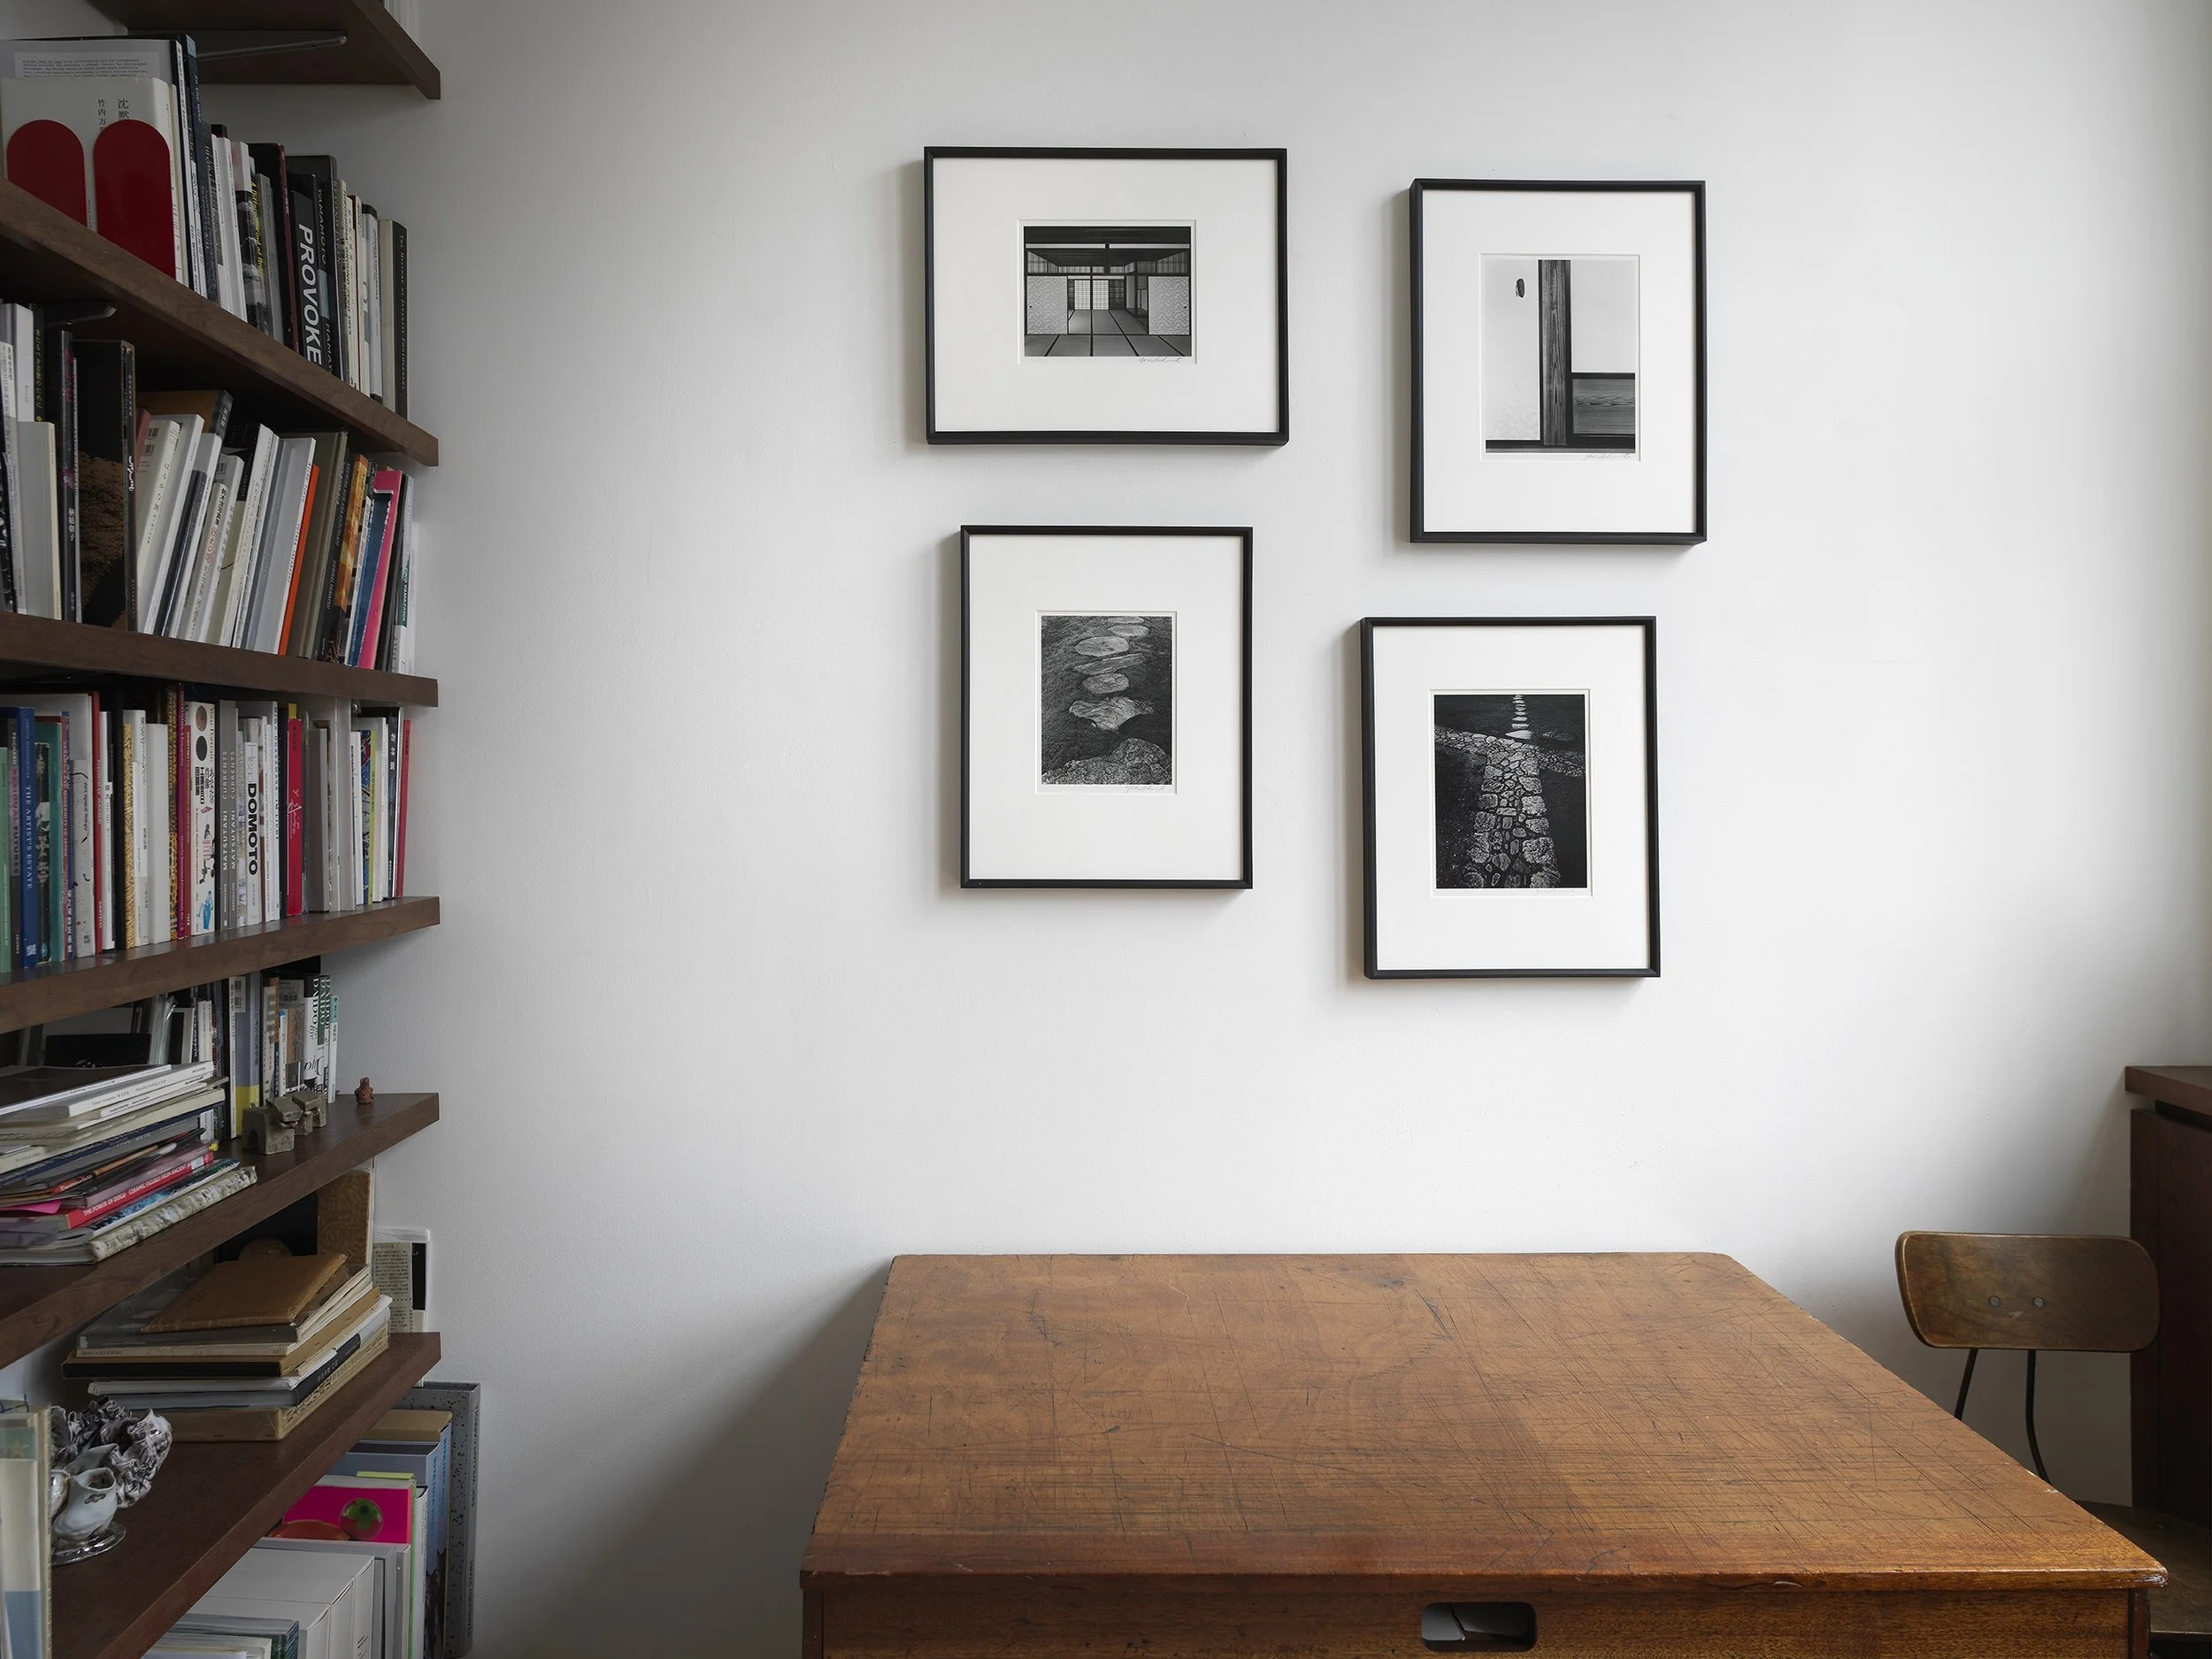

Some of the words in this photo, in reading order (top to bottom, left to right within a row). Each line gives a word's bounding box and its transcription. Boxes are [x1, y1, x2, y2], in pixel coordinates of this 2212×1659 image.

[117, 98, 130, 121] 沈黙
[318, 188, 326, 265] YAMAMOTO
[297, 223, 323, 365] PROVOKE
[325, 323, 334, 373] HAMAY
[248, 783, 258, 876] DOMOTO
[92, 1201, 107, 1211] POWER
